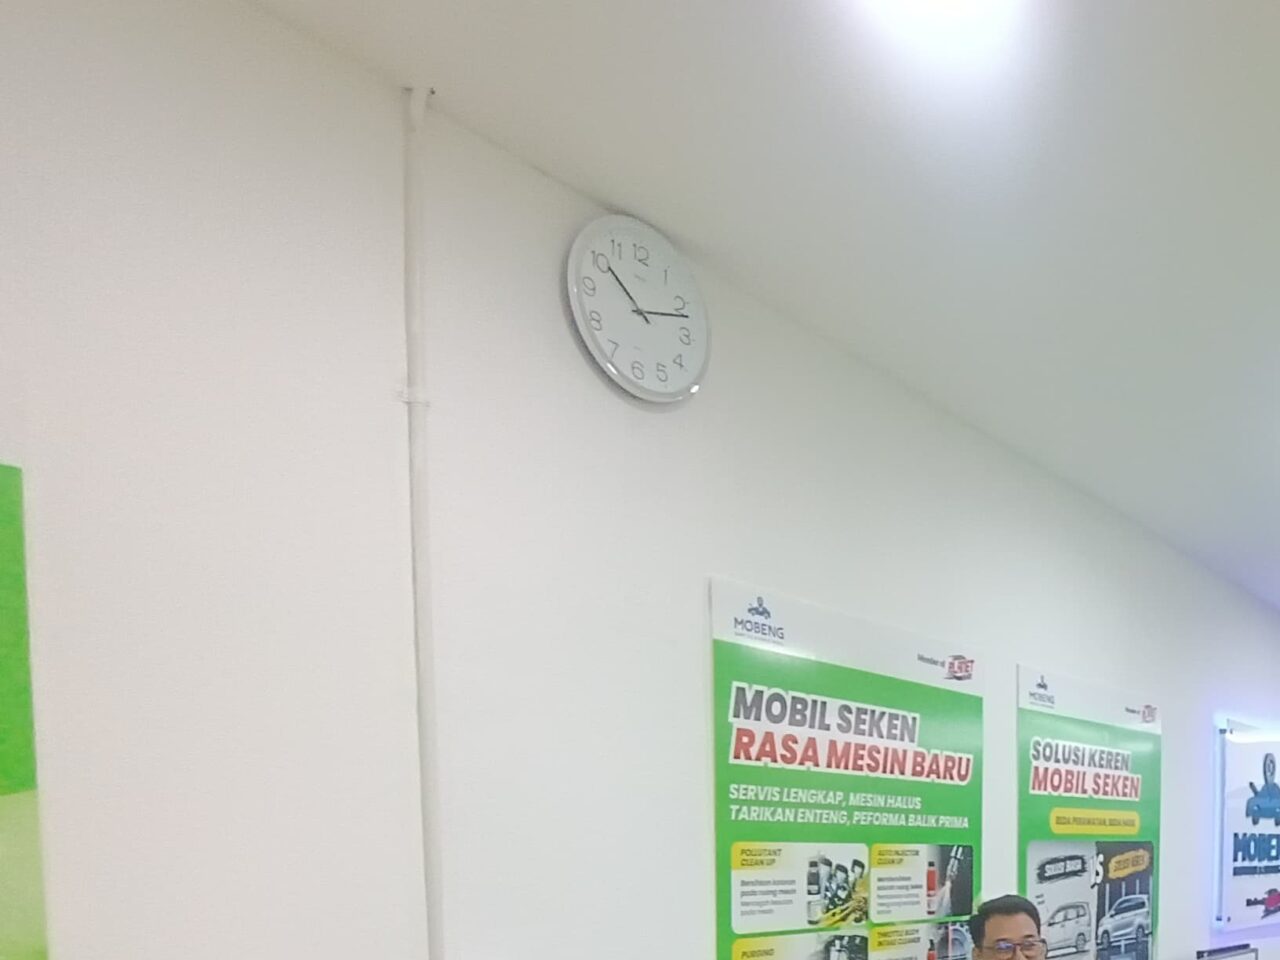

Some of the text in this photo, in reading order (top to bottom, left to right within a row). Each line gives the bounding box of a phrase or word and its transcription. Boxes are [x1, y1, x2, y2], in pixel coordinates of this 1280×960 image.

[611, 239, 623, 260] 11
[633, 243, 650, 267] 12
[591, 250, 610, 273] 10
[582, 276, 597, 297] 9
[673, 295, 686, 315] 2
[589, 310, 603, 332] 8
[678, 326, 692, 346] 3
[607, 338, 620, 359] 7
[631, 360, 645, 381] 6
[656, 362, 669, 382] 5
[672, 353, 684, 370] 4
[733, 617, 784, 640] MOBENG
[732, 686, 917, 743] MOBIL SEKEN
[733, 728, 971, 782] RASA MESIN BARU
[1031, 739, 1130, 771] SOLUSI KEREN
[1031, 766, 1140, 798] MOBIL SEKEN
[729, 784, 922, 809] SERVIS LENGKAP, MESIN HALUS
[730, 805, 968, 829] TARIKAN ENTENG, PEFORMA BALIK PRIMA
